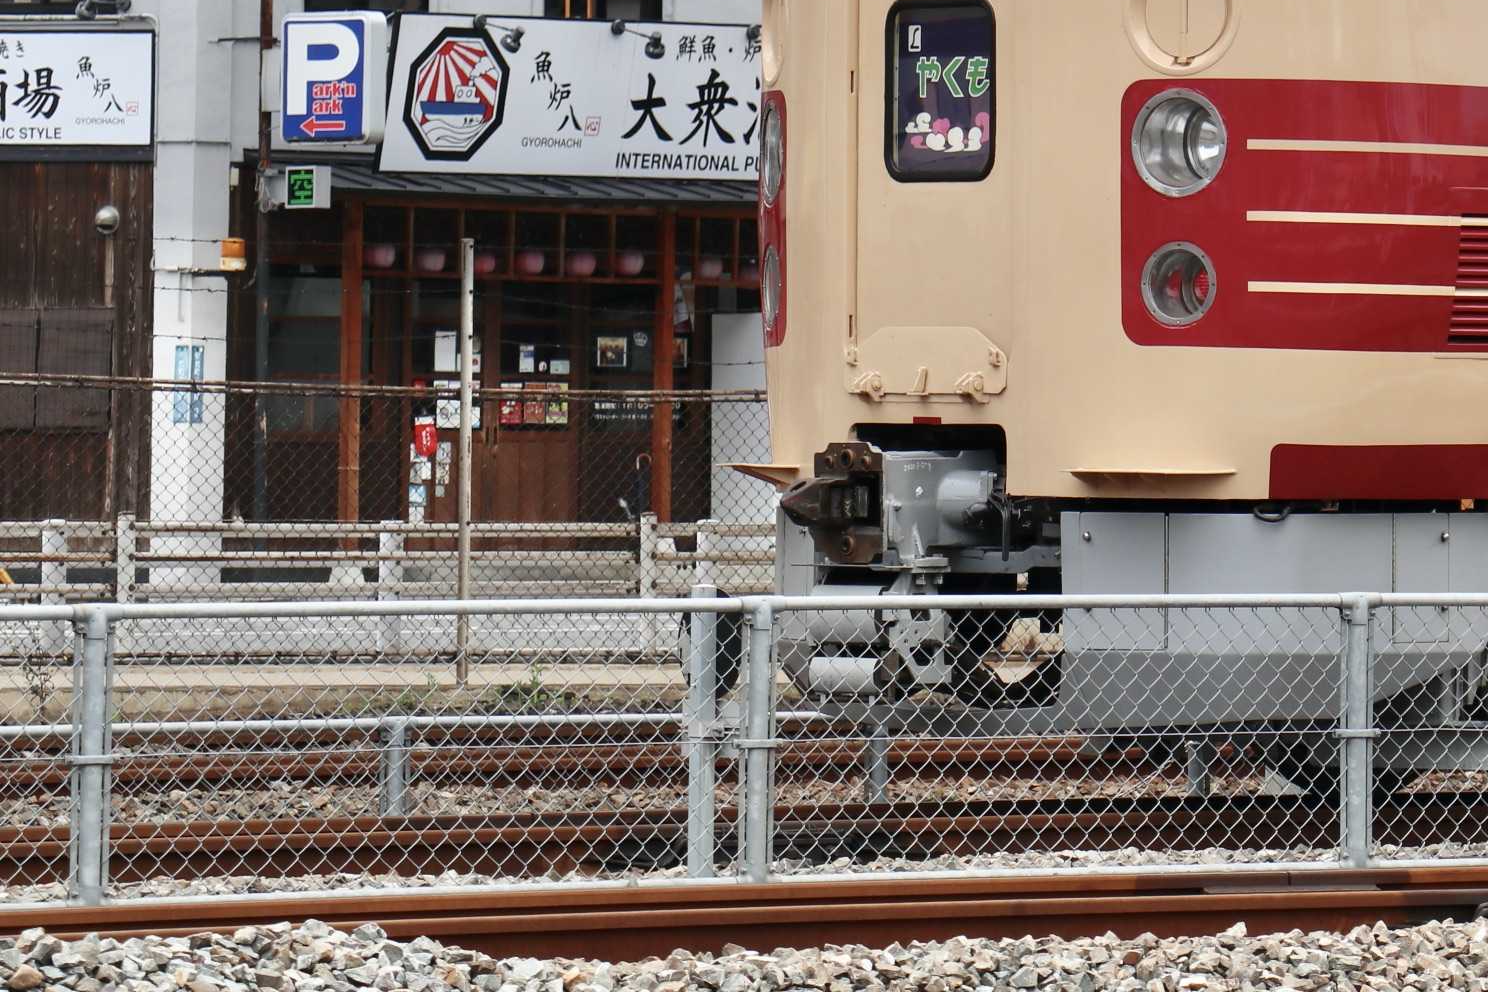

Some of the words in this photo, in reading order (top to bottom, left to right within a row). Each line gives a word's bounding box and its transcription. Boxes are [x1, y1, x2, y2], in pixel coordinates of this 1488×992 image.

[916, 56, 990, 98] やくも
[0, 67, 63, 122] 場
[19, 127, 62, 140] STYLE
[521, 136, 583, 149] GYOROHACHI
[615, 152, 739, 172] INTERNATIONAL
